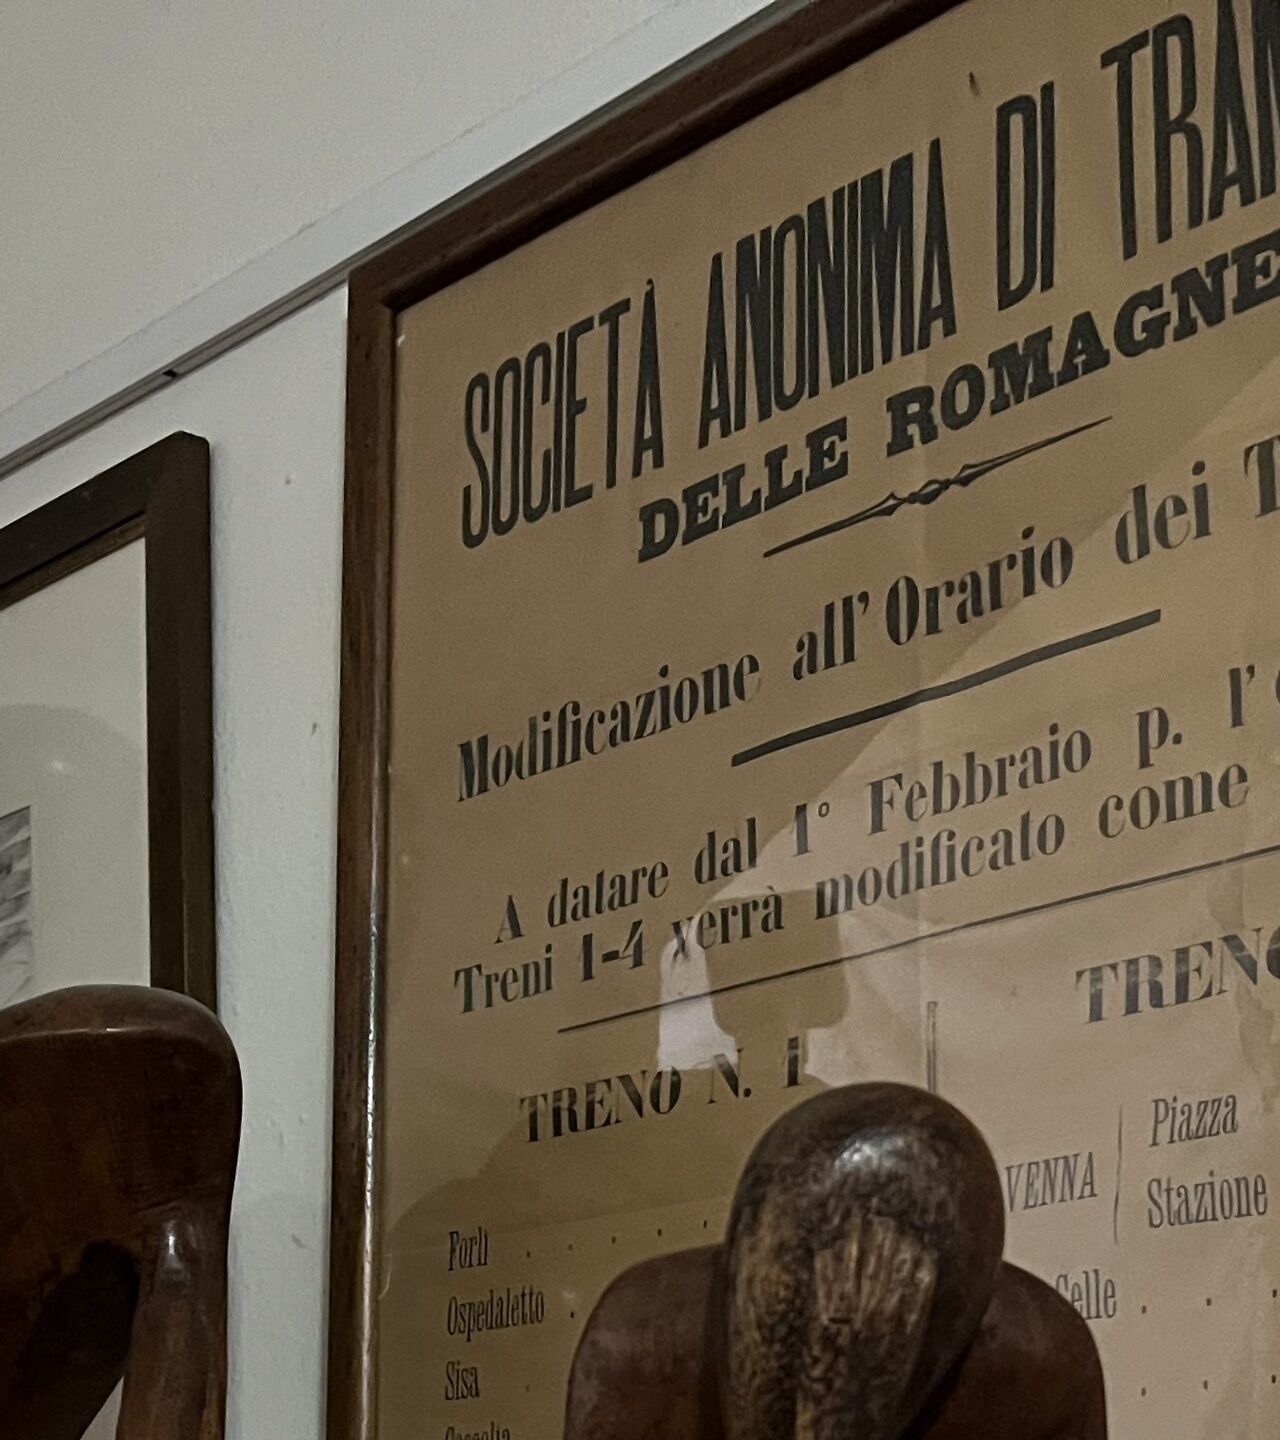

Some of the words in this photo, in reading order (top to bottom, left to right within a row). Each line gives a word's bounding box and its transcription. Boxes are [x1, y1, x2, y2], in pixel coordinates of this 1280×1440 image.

[461, 278, 664, 549] SOCIETÀ
[698, 137, 958, 448] ANONIMA
[995, 80, 1056, 311] DI
[638, 416, 849, 563] DELLE
[457, 652, 761, 802] Modificazione
[1115, 460, 1213, 565] dei
[494, 893, 524, 944] A
[547, 860, 669, 928] datare
[694, 817, 758, 886] dal
[866, 721, 1092, 836] Febbraio
[1134, 706, 1184, 771] p.
[453, 944, 554, 1014] Treni
[579, 918, 645, 983] 1-4
[671, 884, 785, 961] verrà
[814, 809, 1065, 920] modificato
[1097, 762, 1249, 839] come
[519, 1066, 683, 1143] TRENO
[706, 1048, 753, 1105] N.
[1148, 1094, 1239, 1148] Piazza
[1146, 1169, 1269, 1229] Stazione
[446, 1284, 545, 1343] Ospedaletto
[445, 1360, 480, 1401] Sisa
